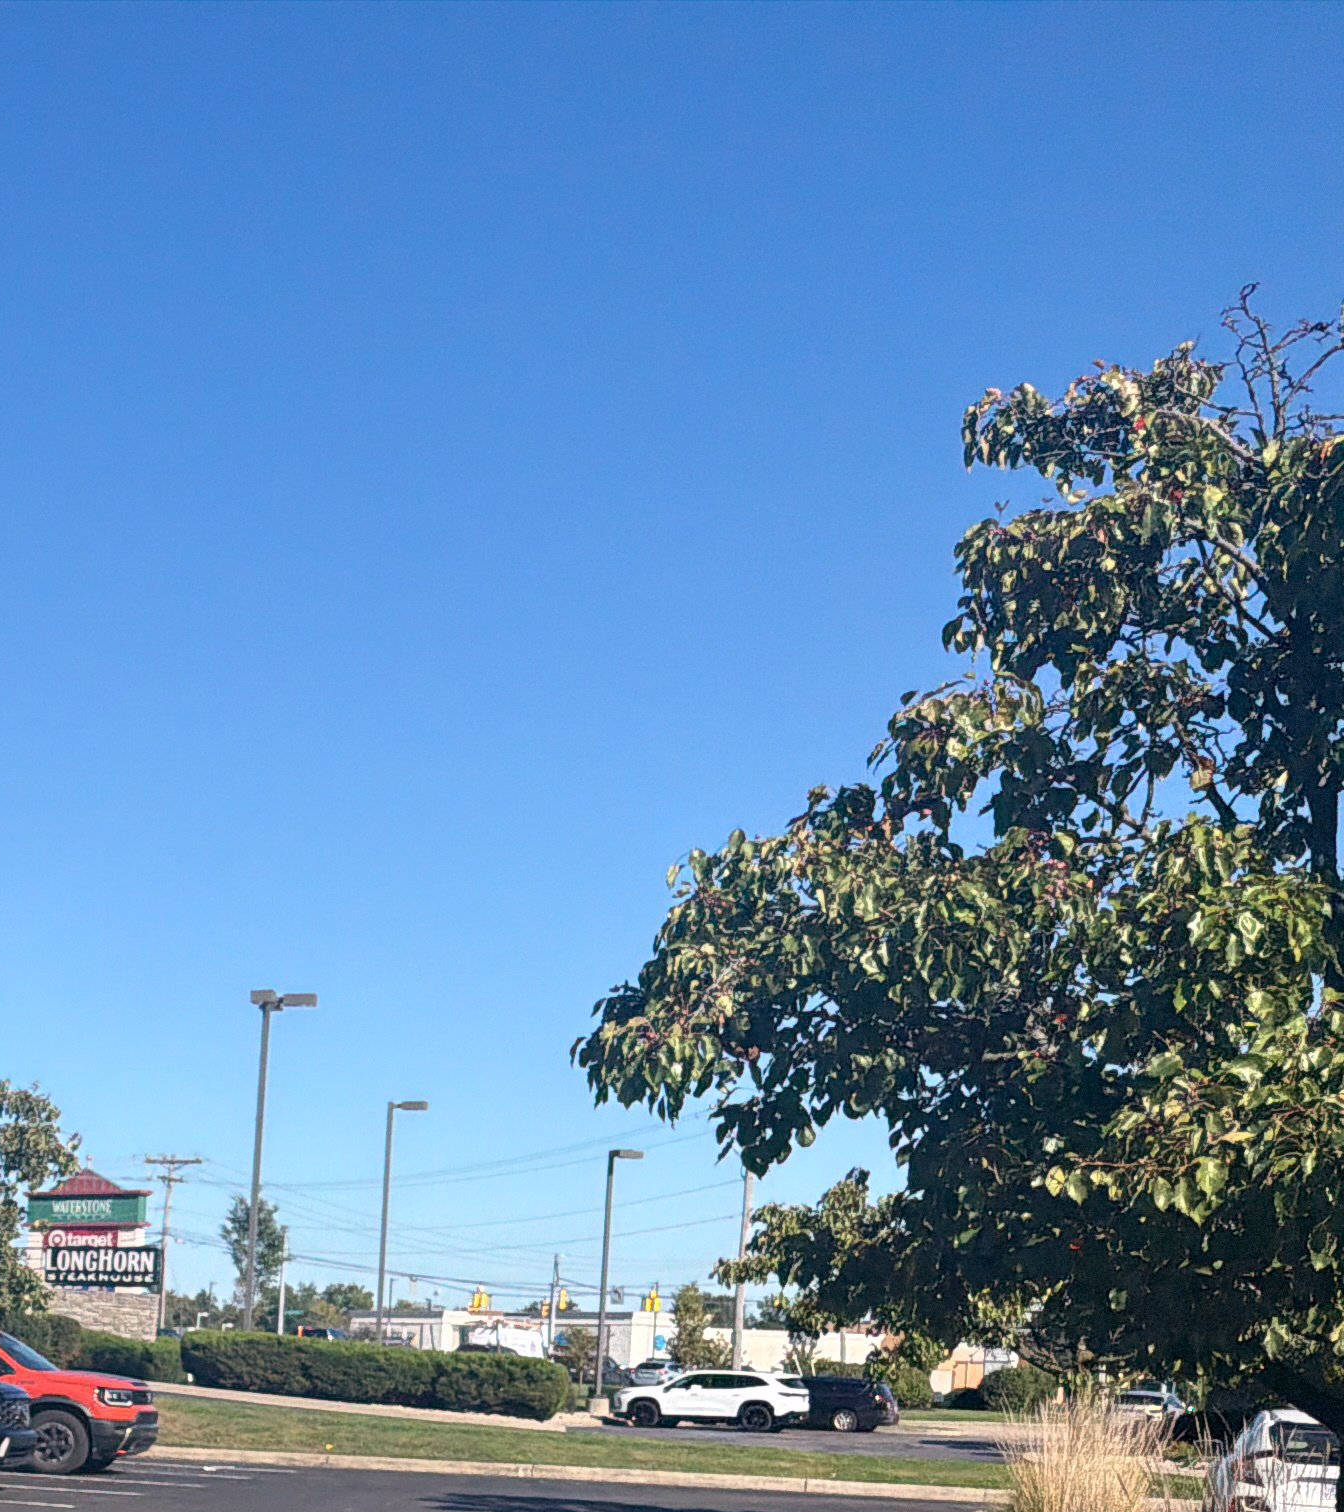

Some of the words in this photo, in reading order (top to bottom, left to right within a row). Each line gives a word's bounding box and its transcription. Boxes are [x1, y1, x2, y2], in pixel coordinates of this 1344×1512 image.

[52, 1199, 112, 1214] WATERSTONE
[67, 1231, 113, 1247] target
[46, 1249, 155, 1273] LONGHORN
[47, 1272, 154, 1282] STEAKHOUSE
